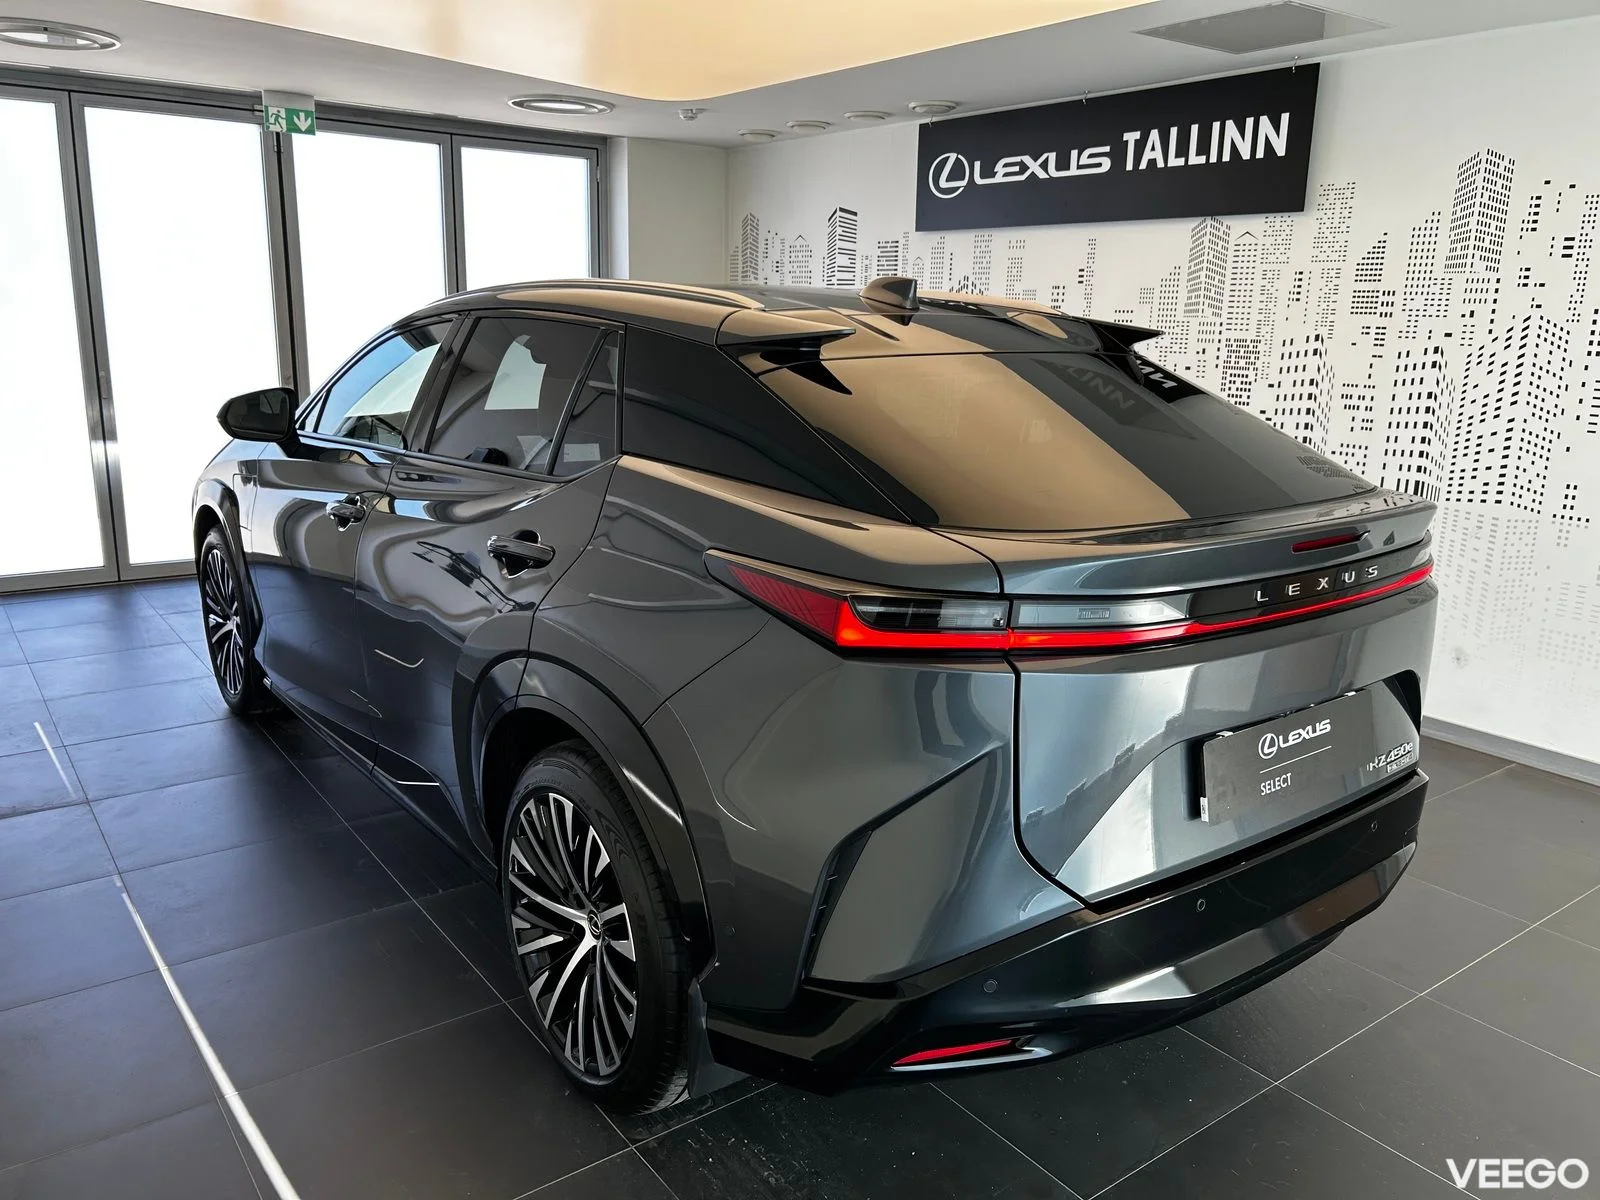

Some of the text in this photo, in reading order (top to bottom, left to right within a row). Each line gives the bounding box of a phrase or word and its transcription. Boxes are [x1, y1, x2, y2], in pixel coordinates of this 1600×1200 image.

[974, 112, 1290, 185] LEXUS TALLINN
[1256, 565, 1379, 602] LEXUS
[1278, 719, 1332, 748] LEXUS
[1260, 772, 1292, 796] SELECT
